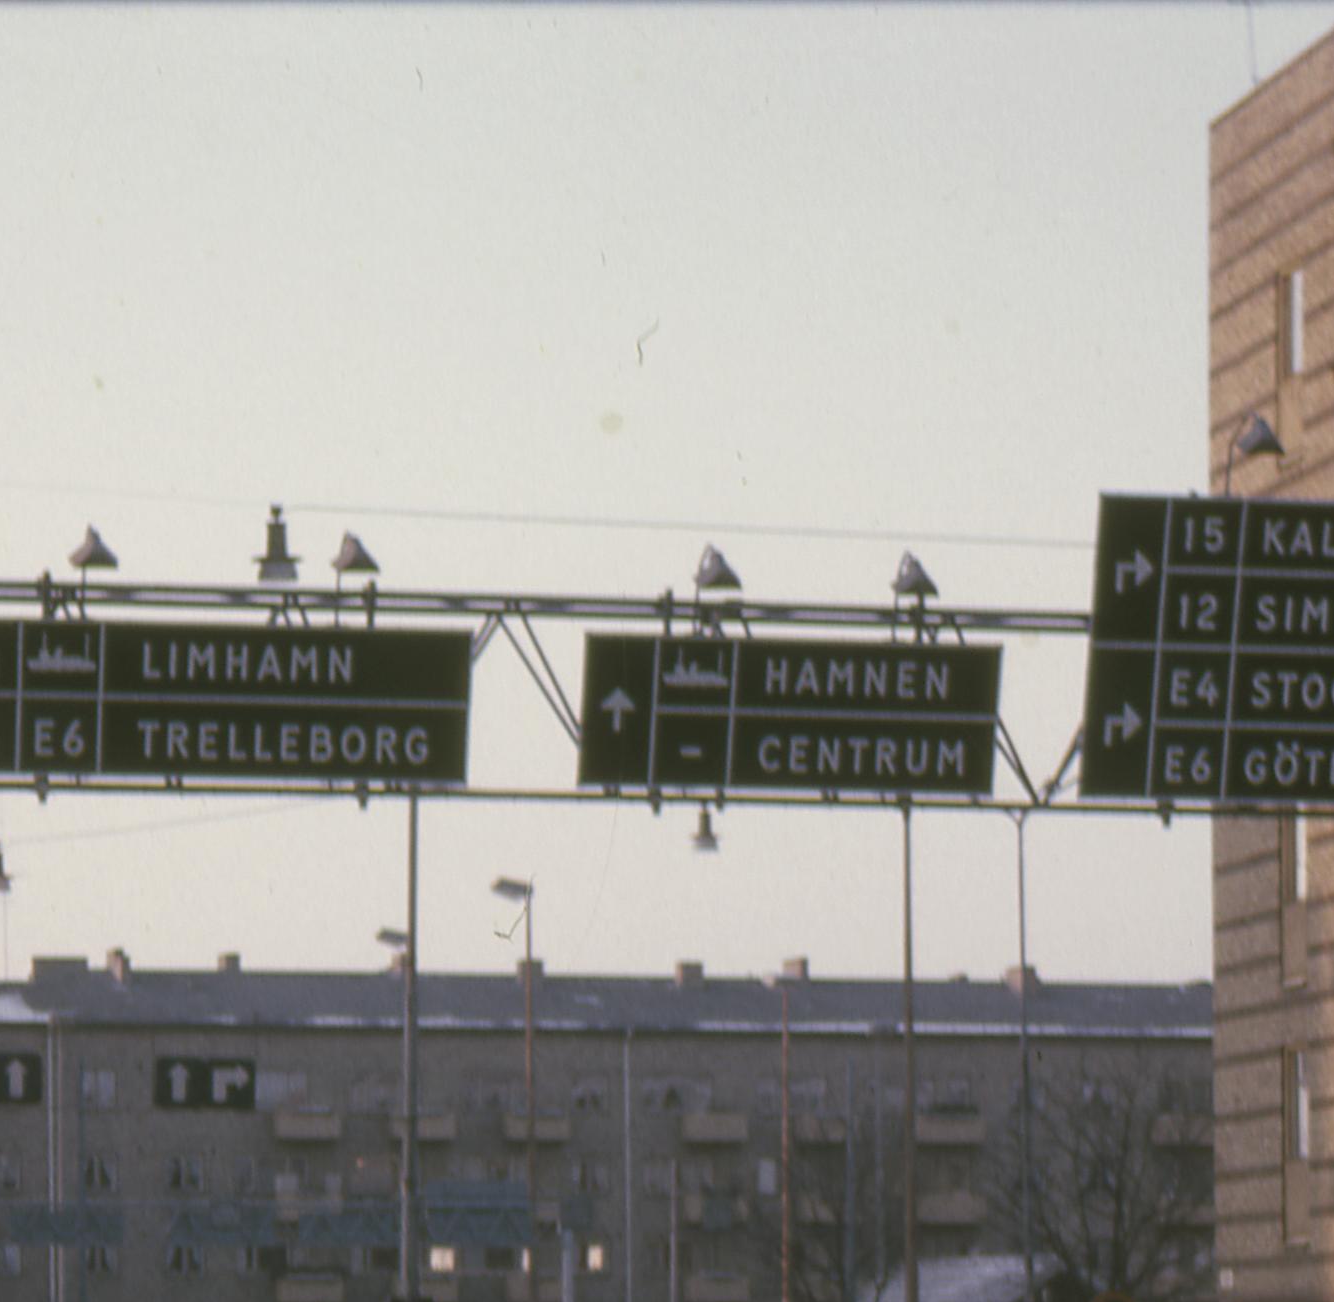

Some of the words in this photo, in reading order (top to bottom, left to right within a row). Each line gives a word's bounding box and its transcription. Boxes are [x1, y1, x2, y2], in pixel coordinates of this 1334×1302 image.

[1183, 516, 1225, 554] 15
[1178, 593, 1218, 632] 12
[142, 641, 355, 685] LIMHAMN
[765, 656, 951, 700] HAMNEN
[1169, 669, 1220, 708] E4
[33, 718, 85, 757] E6
[137, 720, 430, 765] TRELLEBORG
[757, 735, 967, 777] CENTRUM
[1164, 746, 1212, 784] E6
